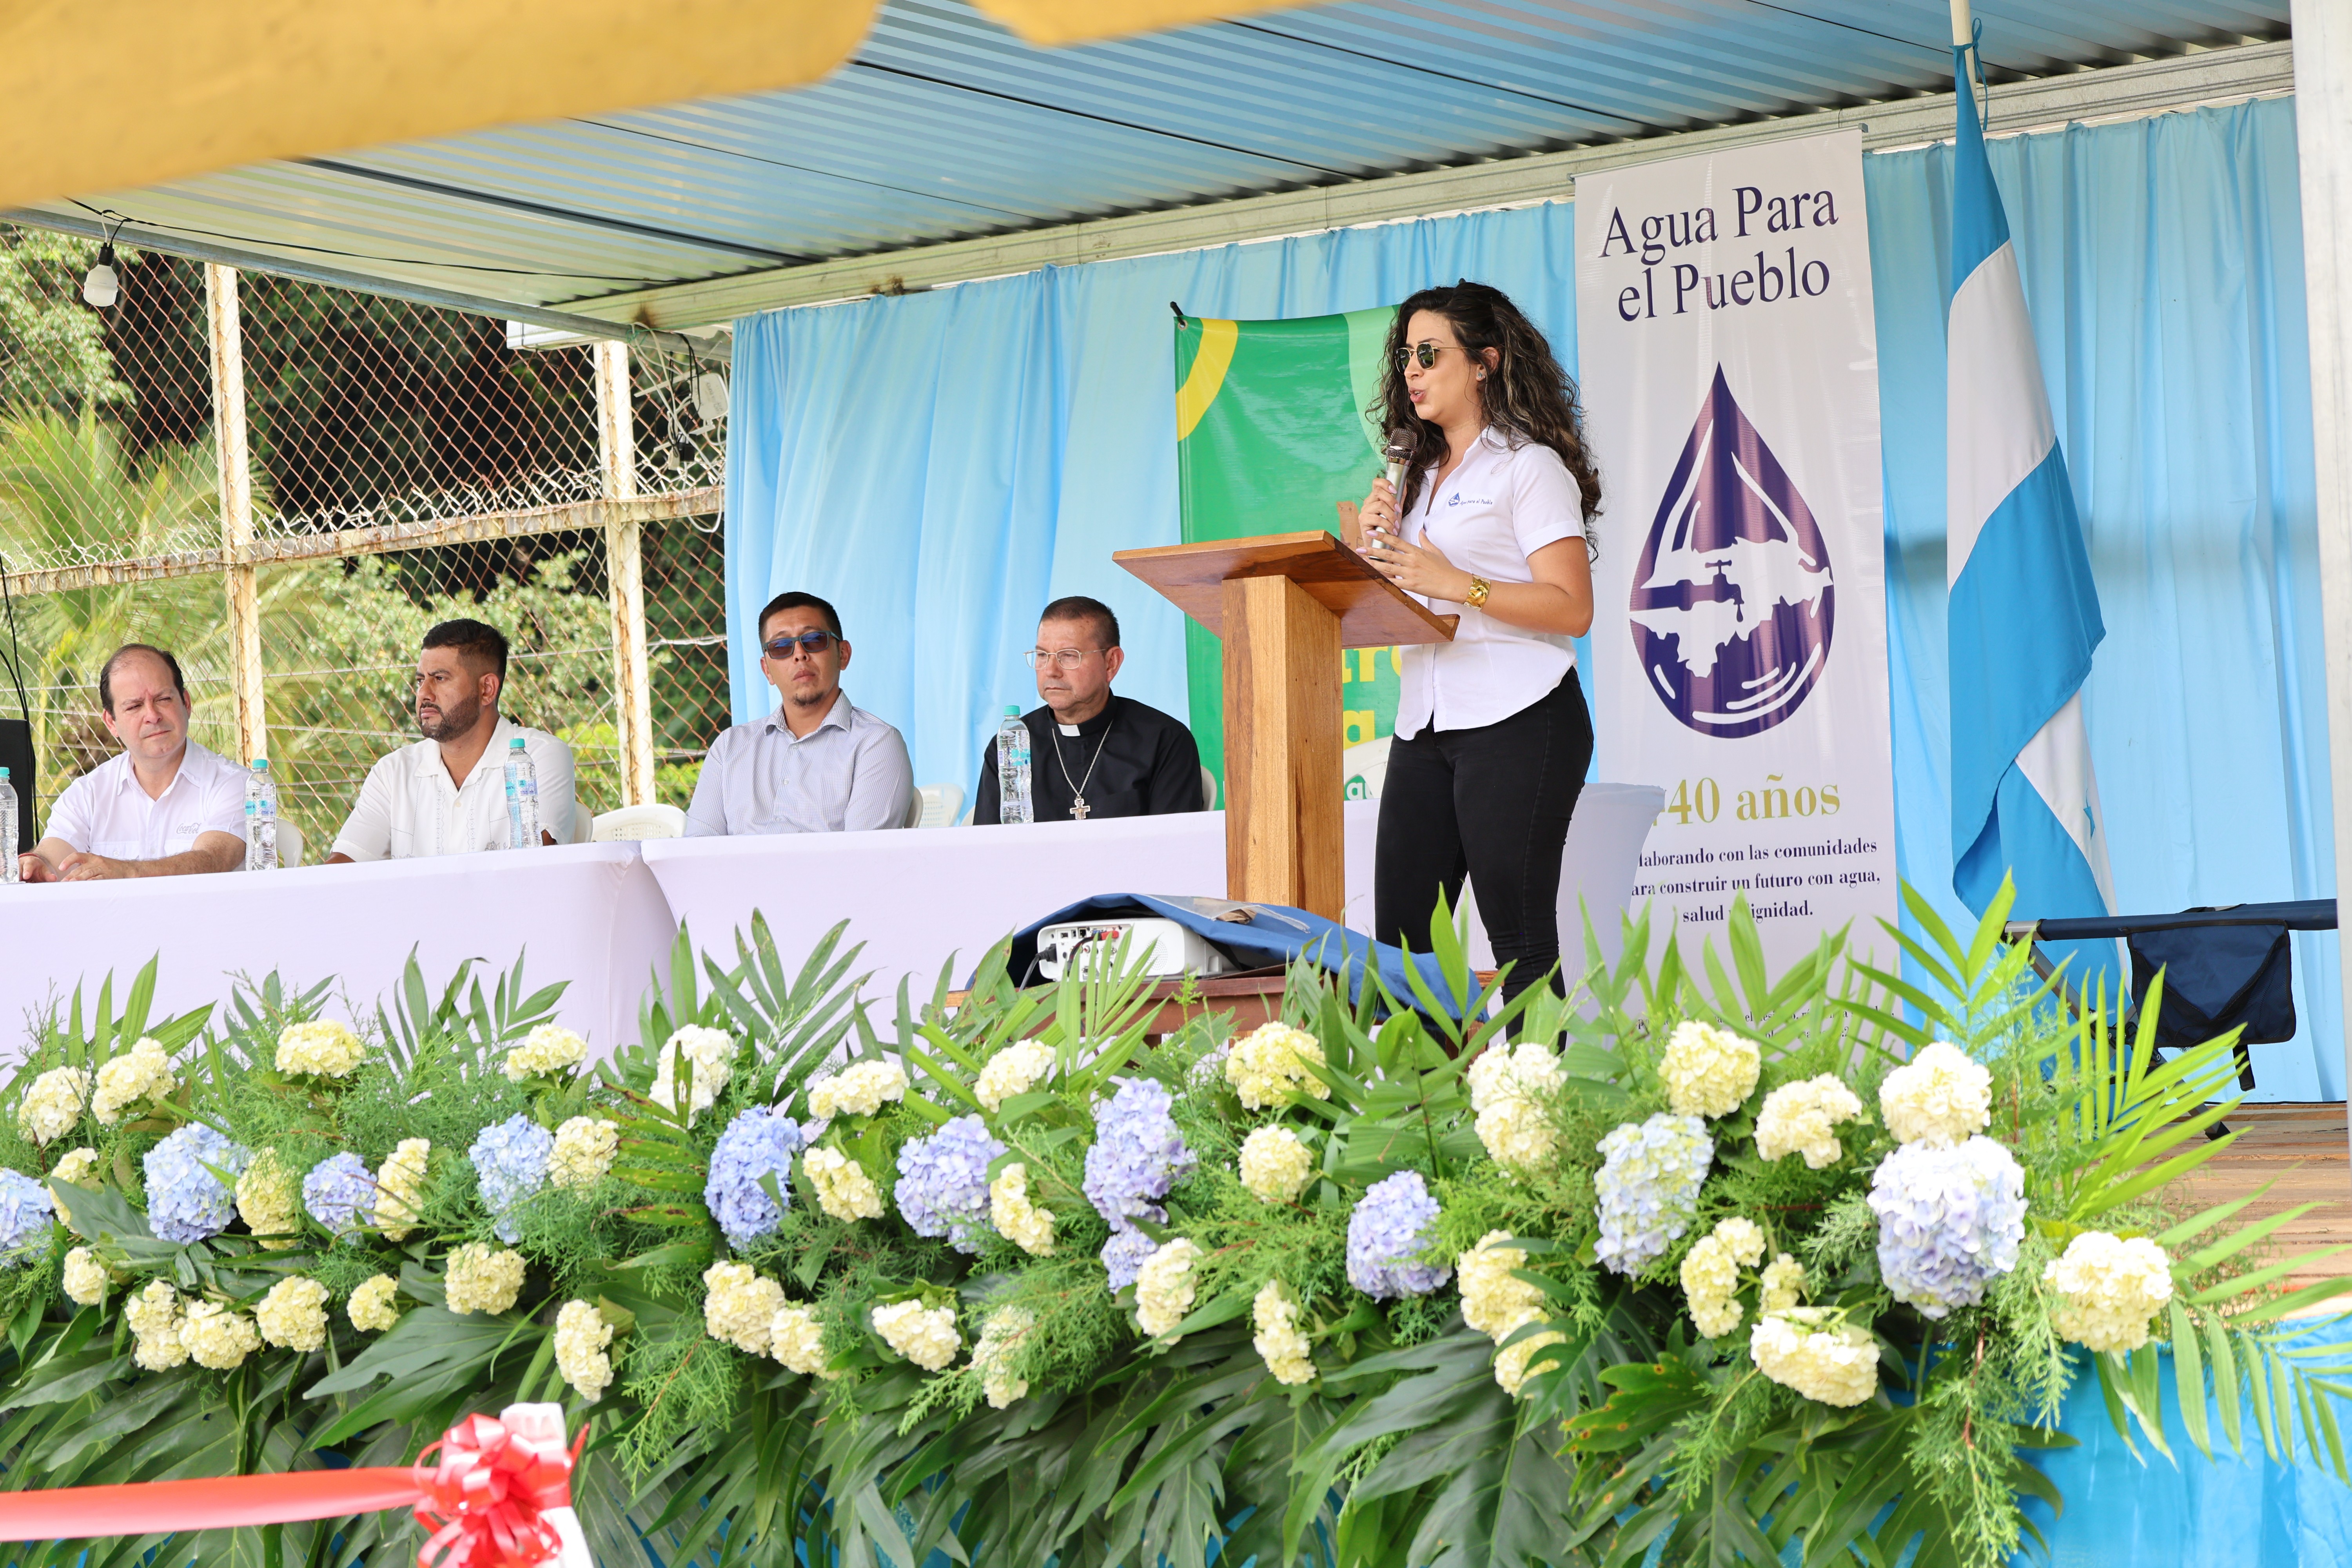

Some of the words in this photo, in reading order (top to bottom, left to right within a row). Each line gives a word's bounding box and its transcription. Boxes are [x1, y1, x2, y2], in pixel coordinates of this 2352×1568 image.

[1598, 206, 1719, 266] Agua
[1732, 186, 1839, 238] Para
[1618, 267, 1657, 321] el
[1670, 247, 1830, 315] Pueblo
[1653, 777, 1720, 826] 40
[1737, 773, 1840, 821] años
[1638, 848, 1713, 867] laborando
[1719, 850, 1744, 862] con
[1749, 844, 1769, 860] las
[1774, 837, 1877, 859] comunidades
[1632, 884, 1655, 896] ara
[1660, 876, 1727, 894] construir
[1732, 878, 1750, 890] un
[1755, 873, 1802, 889] futuro
[1808, 873, 1833, 886] con
[1839, 871, 1880, 889] agua,
[1683, 905, 1724, 923] salud
[1747, 900, 1813, 924] ignidad.
